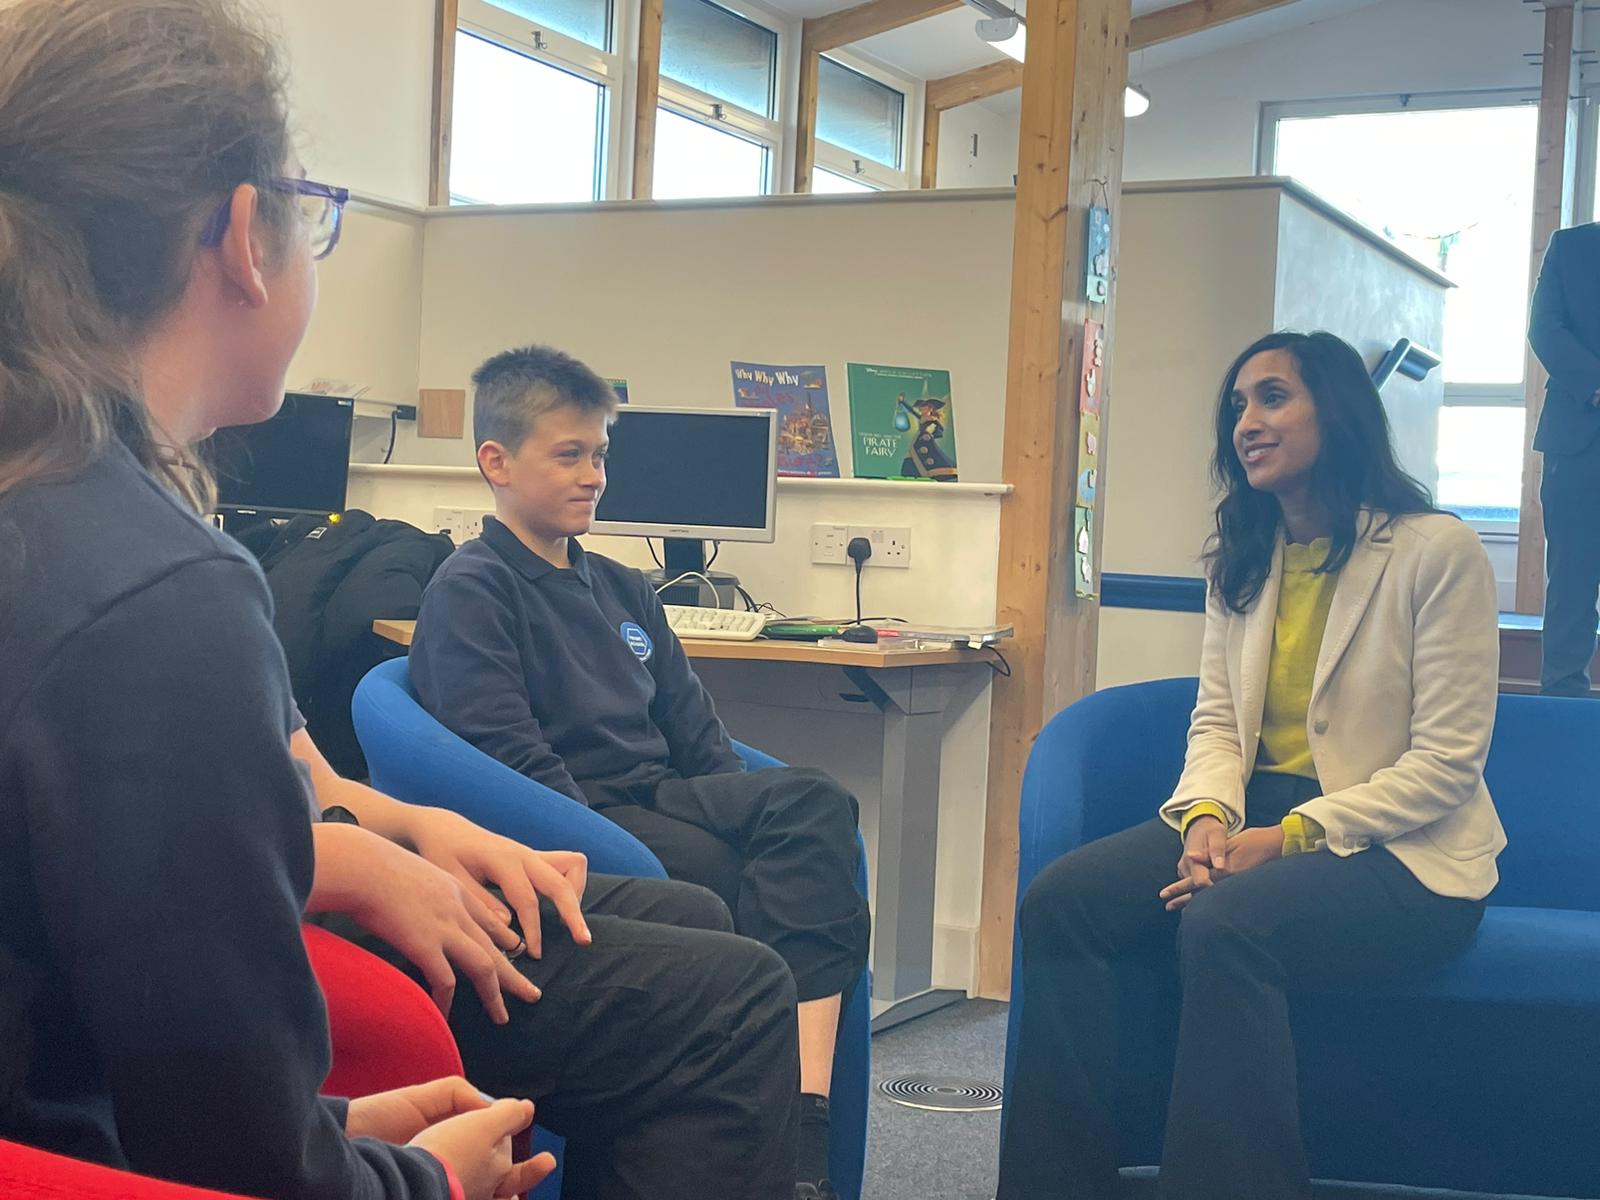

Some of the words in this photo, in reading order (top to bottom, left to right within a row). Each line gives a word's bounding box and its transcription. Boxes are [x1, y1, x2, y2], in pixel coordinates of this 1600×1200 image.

[735, 368, 753, 381] Why
[754, 369, 775, 386] Why
[775, 370, 800, 387] Why
[863, 436, 897, 448] PIRATE
[865, 446, 897, 458] FAIRY
